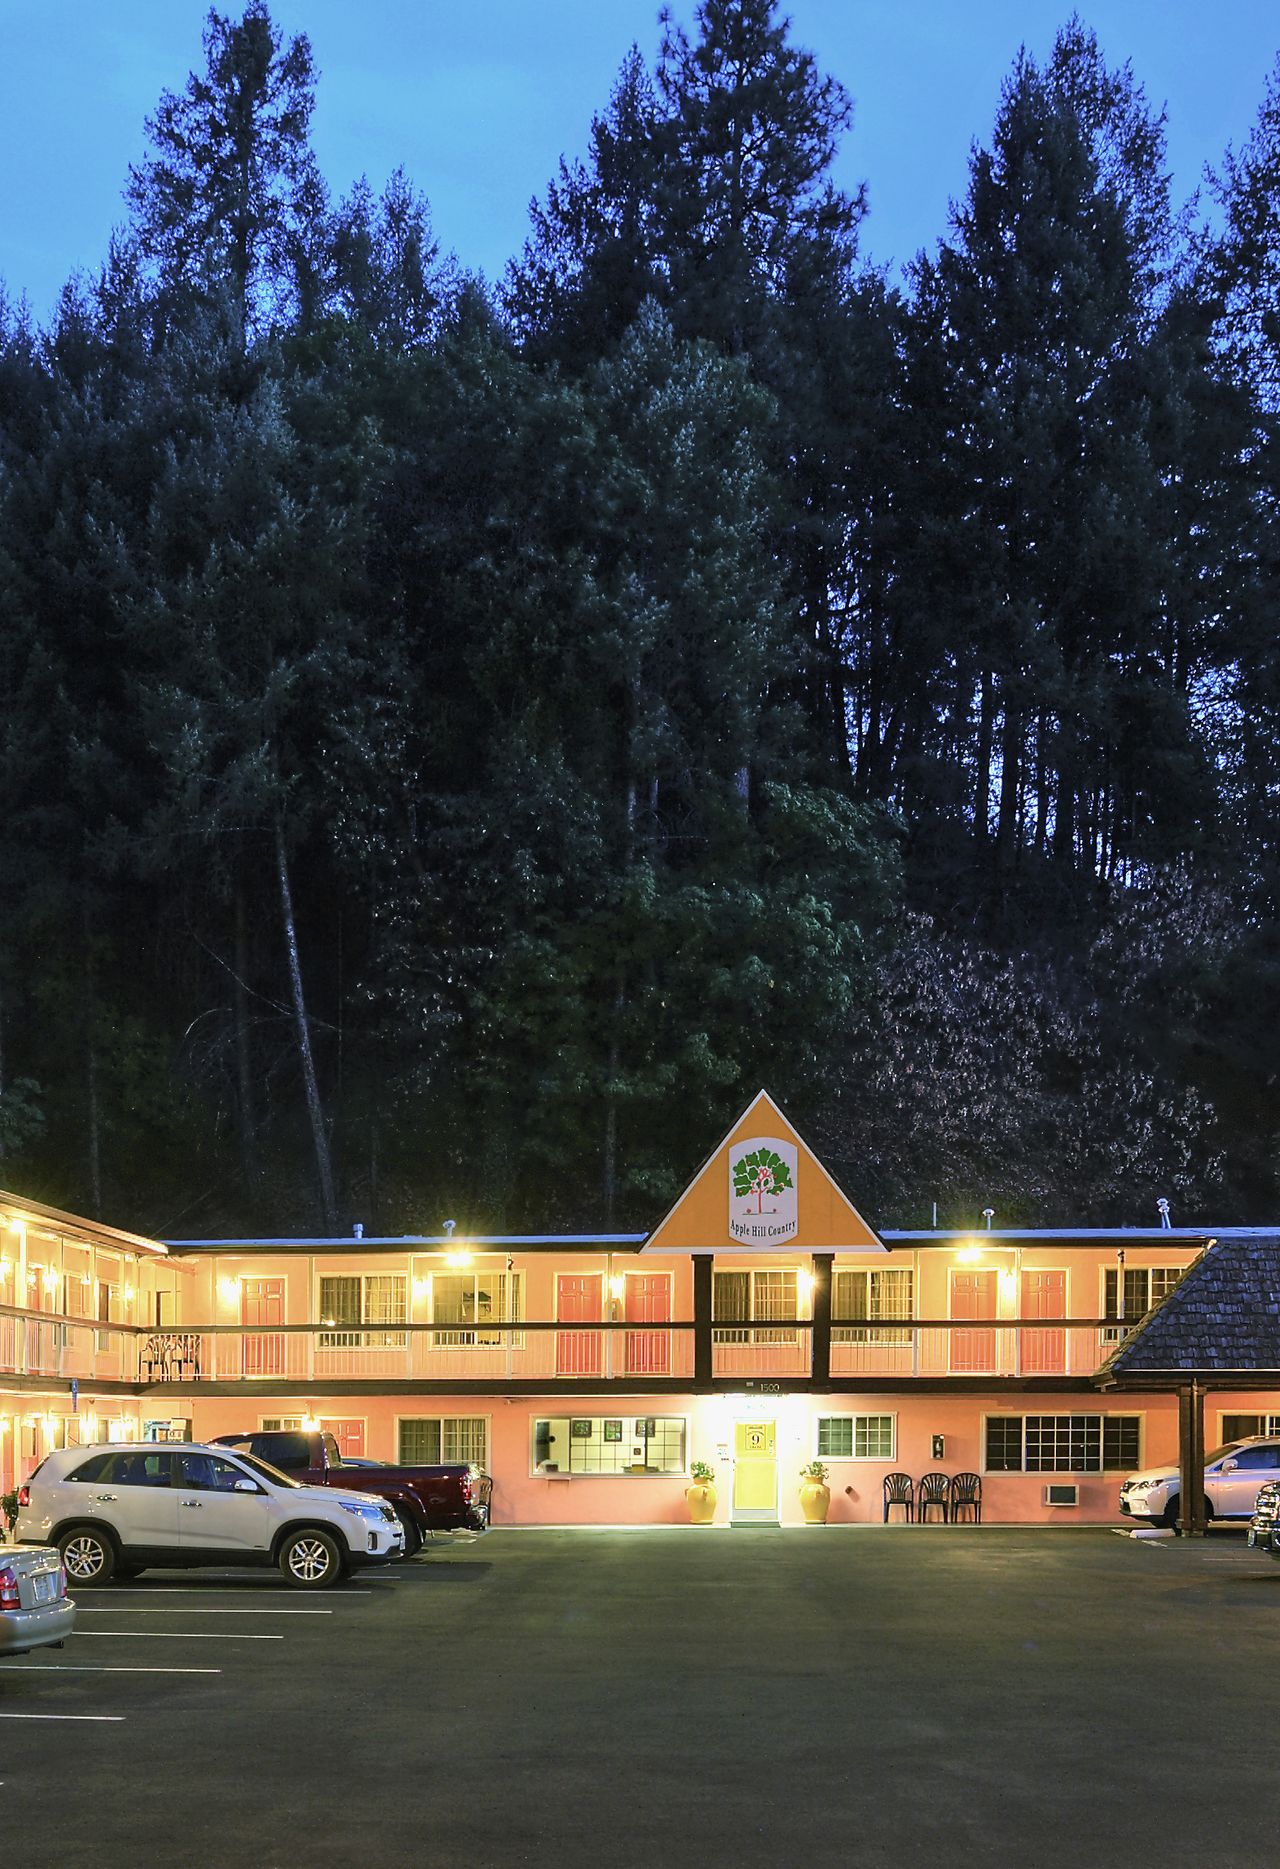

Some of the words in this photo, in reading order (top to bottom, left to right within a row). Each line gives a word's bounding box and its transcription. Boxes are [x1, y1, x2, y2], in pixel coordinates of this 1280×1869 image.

[730, 1219, 750, 1237] Apple
[751, 1225, 766, 1237] Hill
[768, 1221, 796, 1236] Country
[760, 1384, 780, 1392] 1500
[752, 1435, 760, 1445] 9
